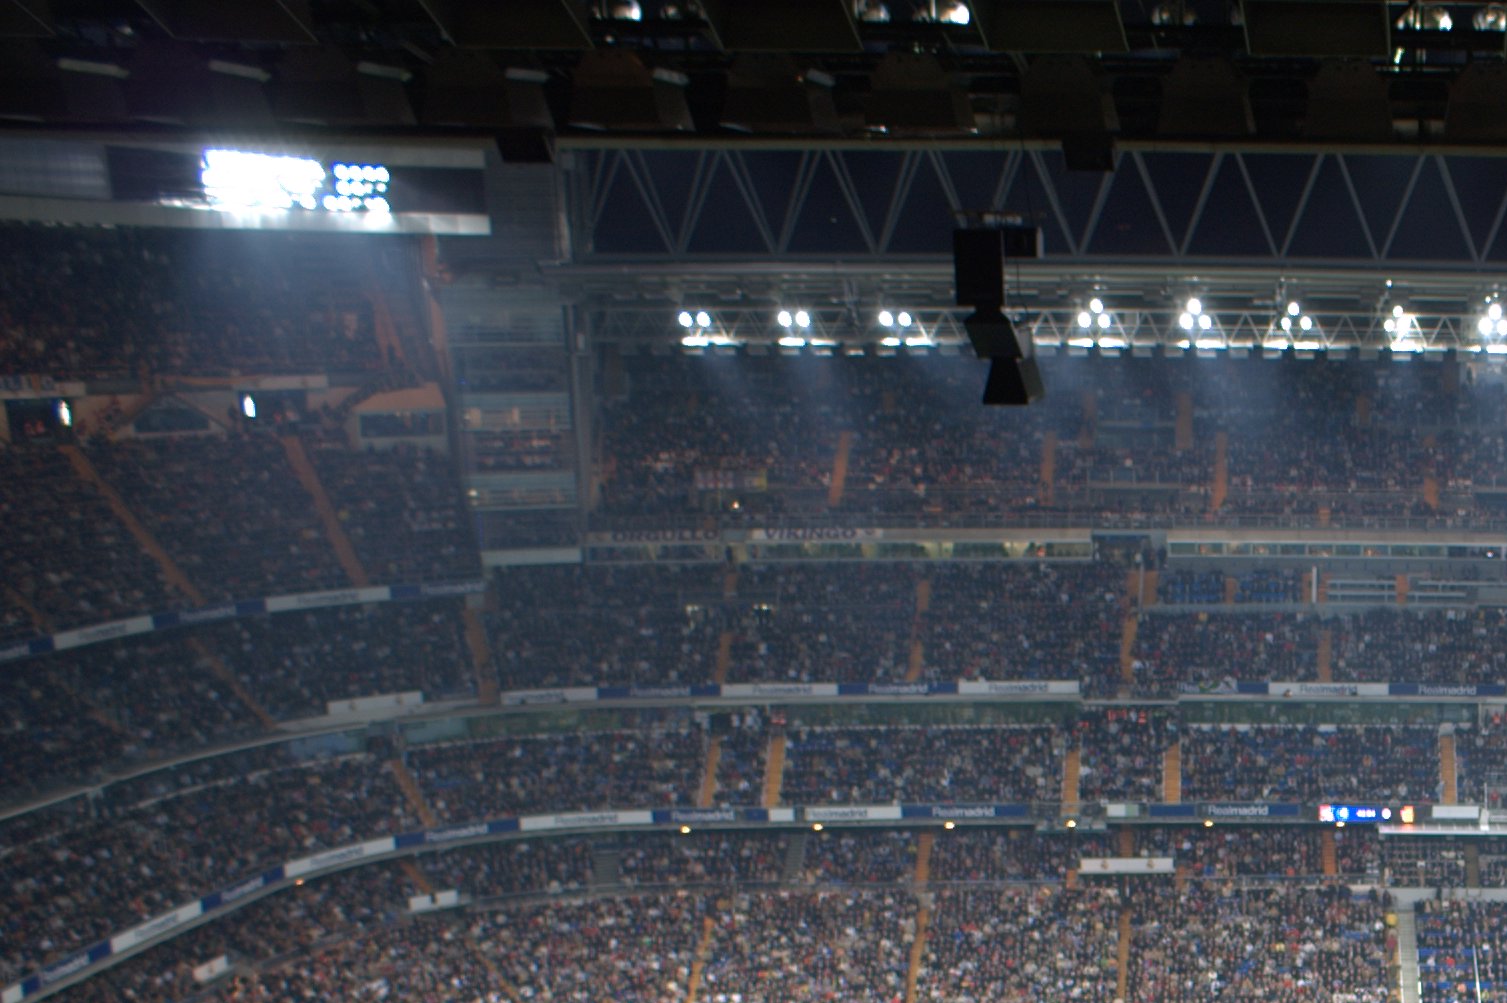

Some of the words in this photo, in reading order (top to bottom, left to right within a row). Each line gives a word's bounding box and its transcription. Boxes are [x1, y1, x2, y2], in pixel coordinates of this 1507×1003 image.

[612, 528, 720, 542] ORGULLO
[766, 528, 856, 540] VIKINGO
[1207, 804, 1269, 816] Realmadrid
